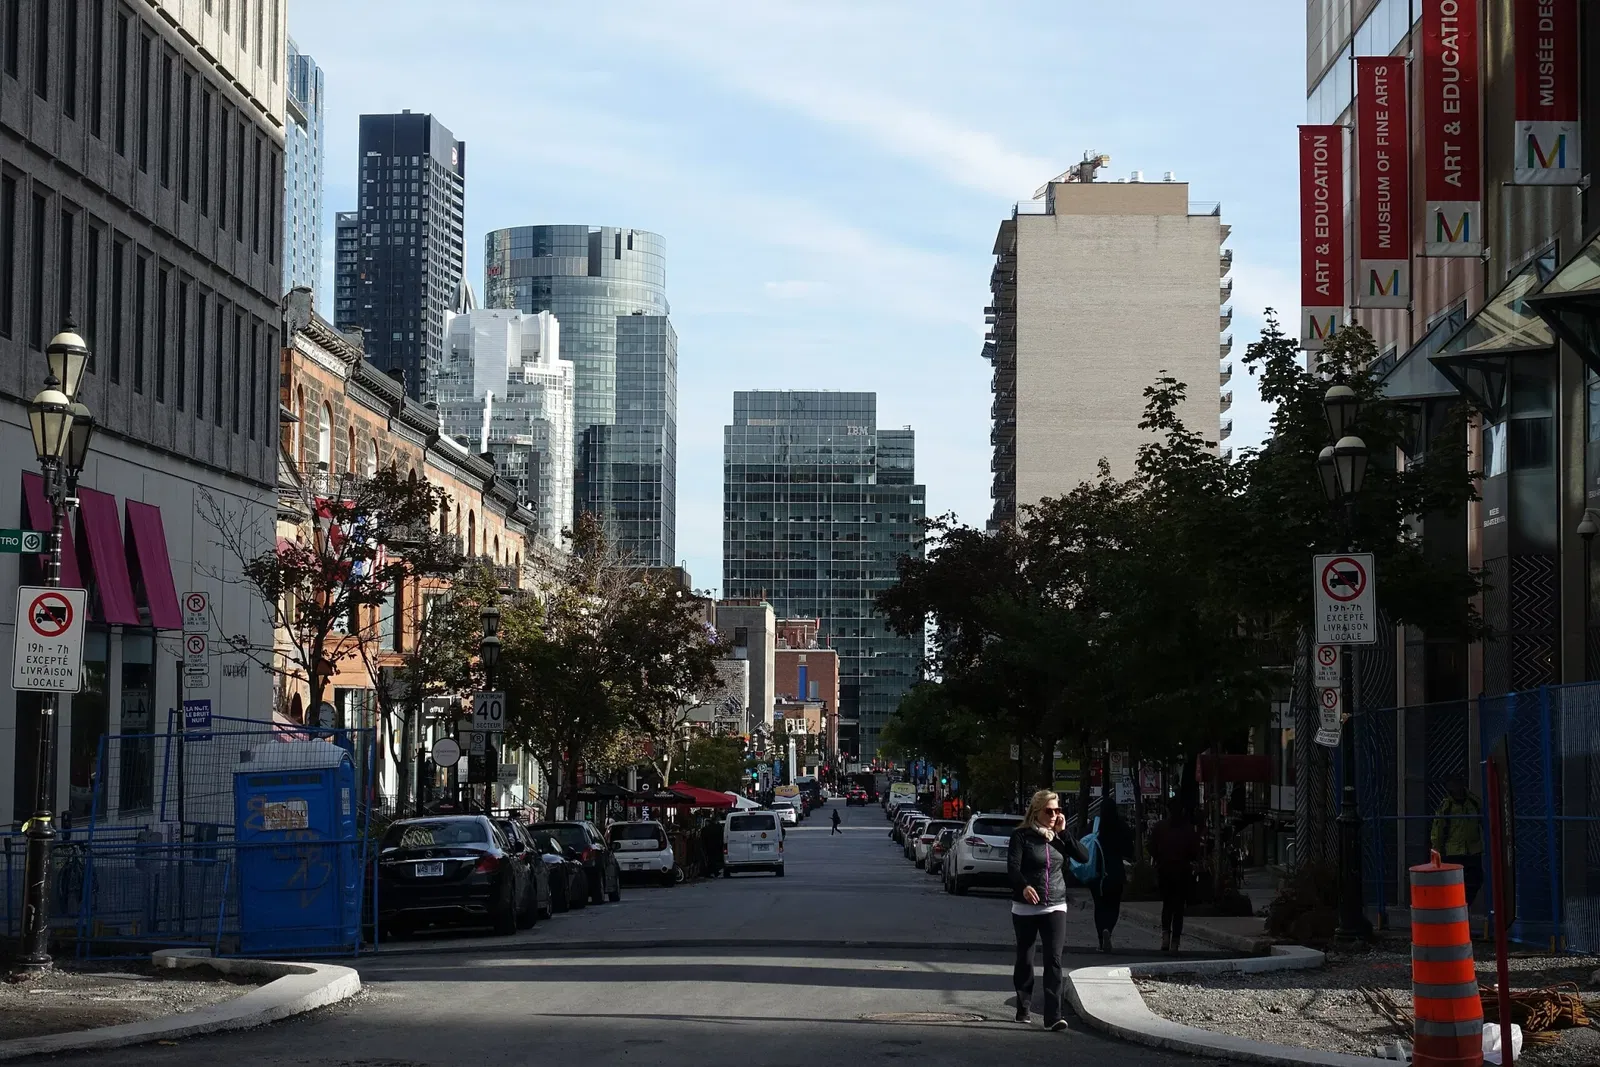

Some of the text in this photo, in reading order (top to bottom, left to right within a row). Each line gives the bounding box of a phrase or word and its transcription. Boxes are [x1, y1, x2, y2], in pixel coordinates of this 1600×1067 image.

[1536, 38, 1554, 106] MUSÉE
[1441, 0, 1461, 187] ART & EDUCATIO
[1375, 65, 1391, 248] MUSEUM OF FINE ARTS
[1314, 135, 1330, 297] ART & EDUCATION
[847, 426, 869, 436] IBM
[0, 536, 19, 546] TRO
[1328, 604, 1362, 612] 19h-7h
[1326, 612, 1364, 622] EXCEPTÉ
[1323, 623, 1368, 632] LIVRAISON
[1330, 632, 1362, 641] LOCALE
[27, 643, 44, 654] 19h
[57, 644, 69, 655] 7h
[26, 655, 69, 666] EXCEPTÉ
[20, 666, 73, 677] LIVRAISON
[27, 678, 65, 688] LOCALE
[476, 700, 502, 721] 40
